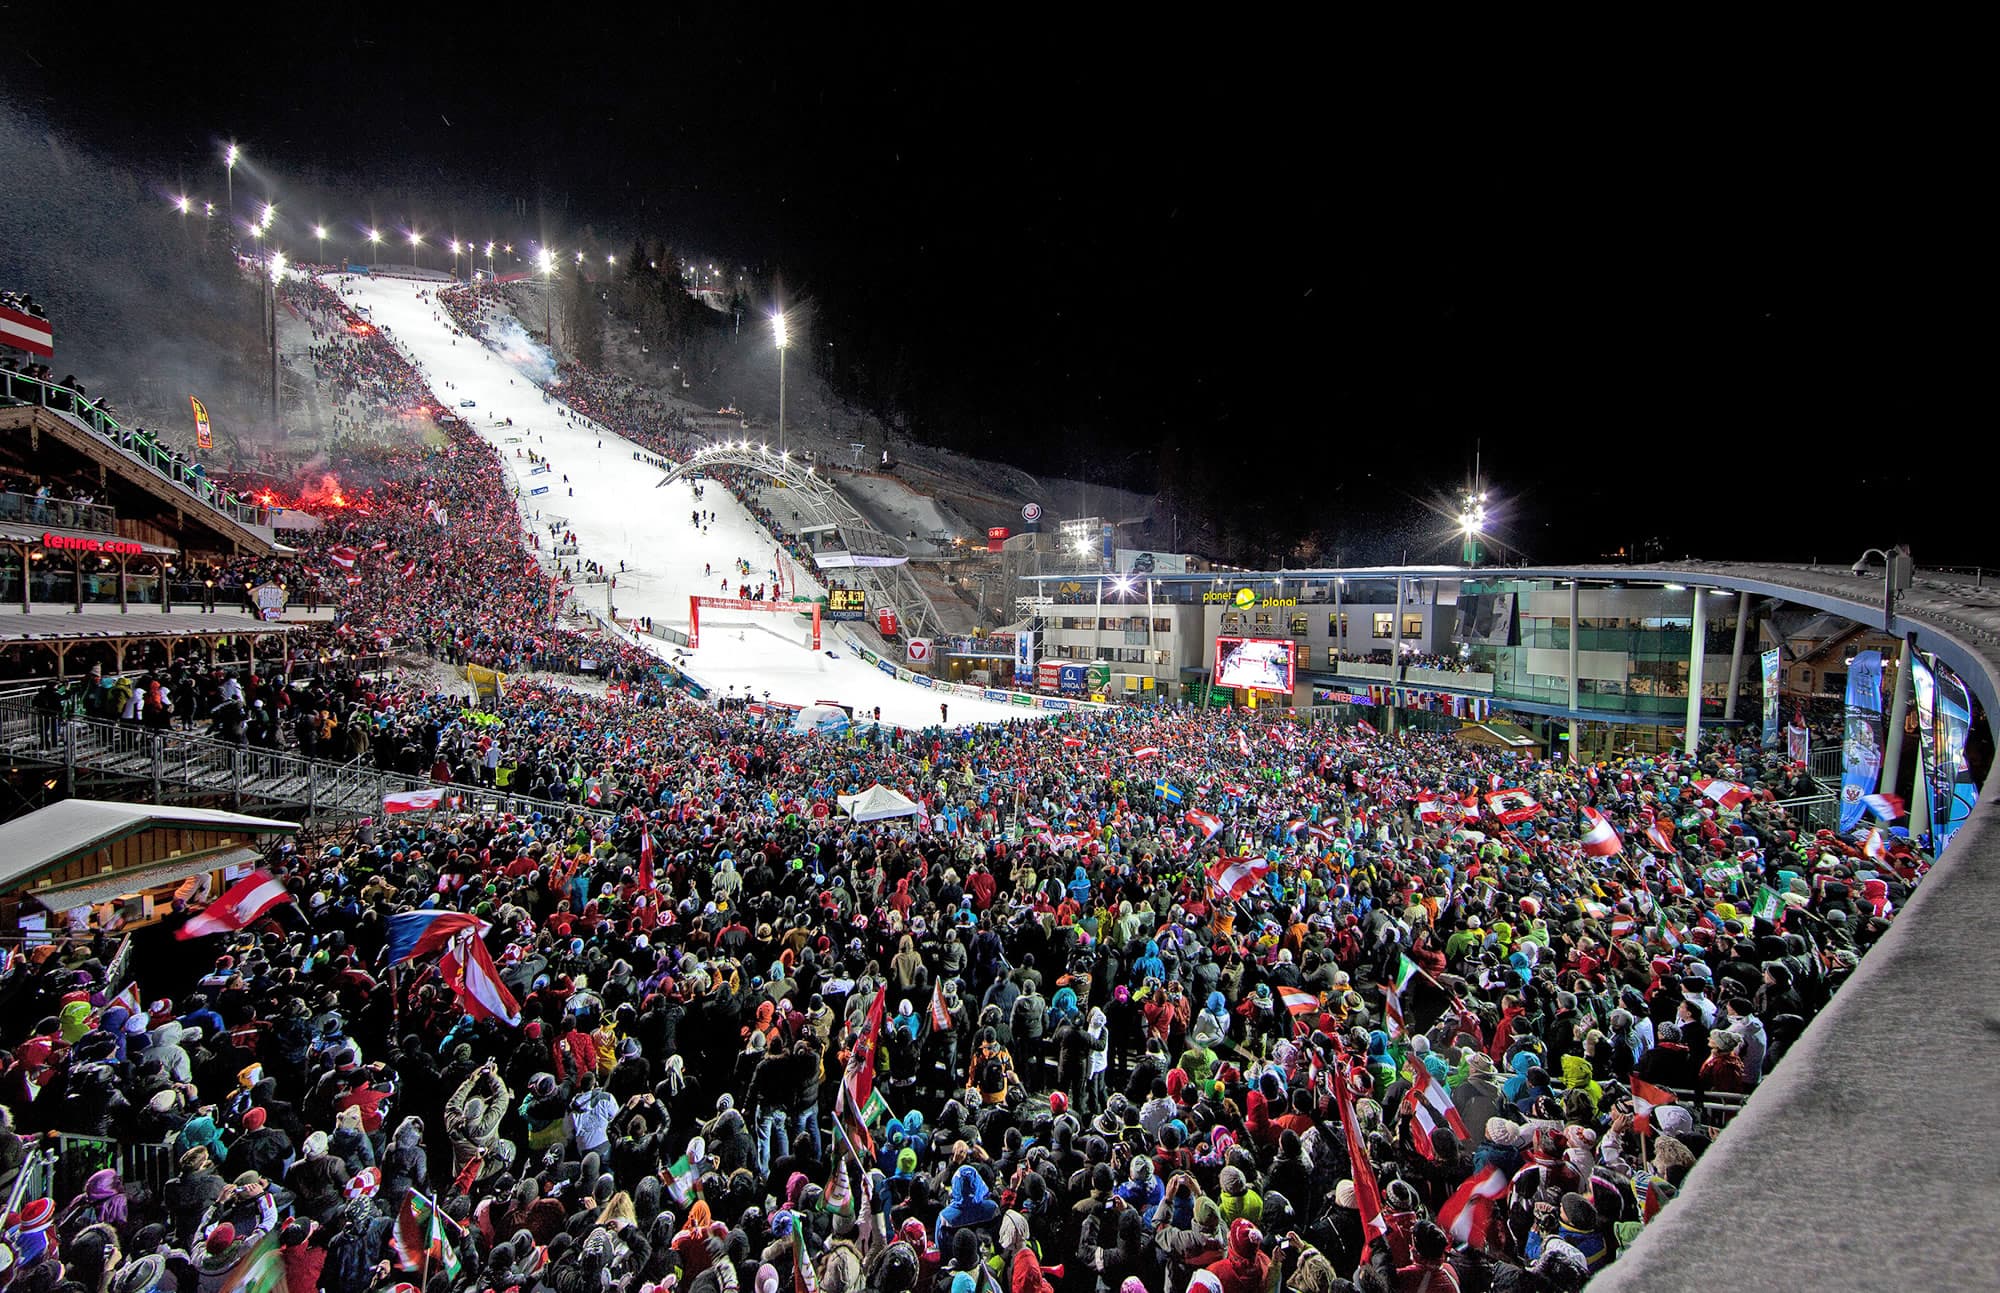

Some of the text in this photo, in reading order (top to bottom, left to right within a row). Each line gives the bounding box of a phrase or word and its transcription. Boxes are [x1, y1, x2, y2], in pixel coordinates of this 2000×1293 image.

[988, 529, 1004, 537] ORF
[43, 531, 142, 554] tenne.com
[1203, 591, 1297, 608] planet planai
[1051, 701, 1068, 710] UNIQA
